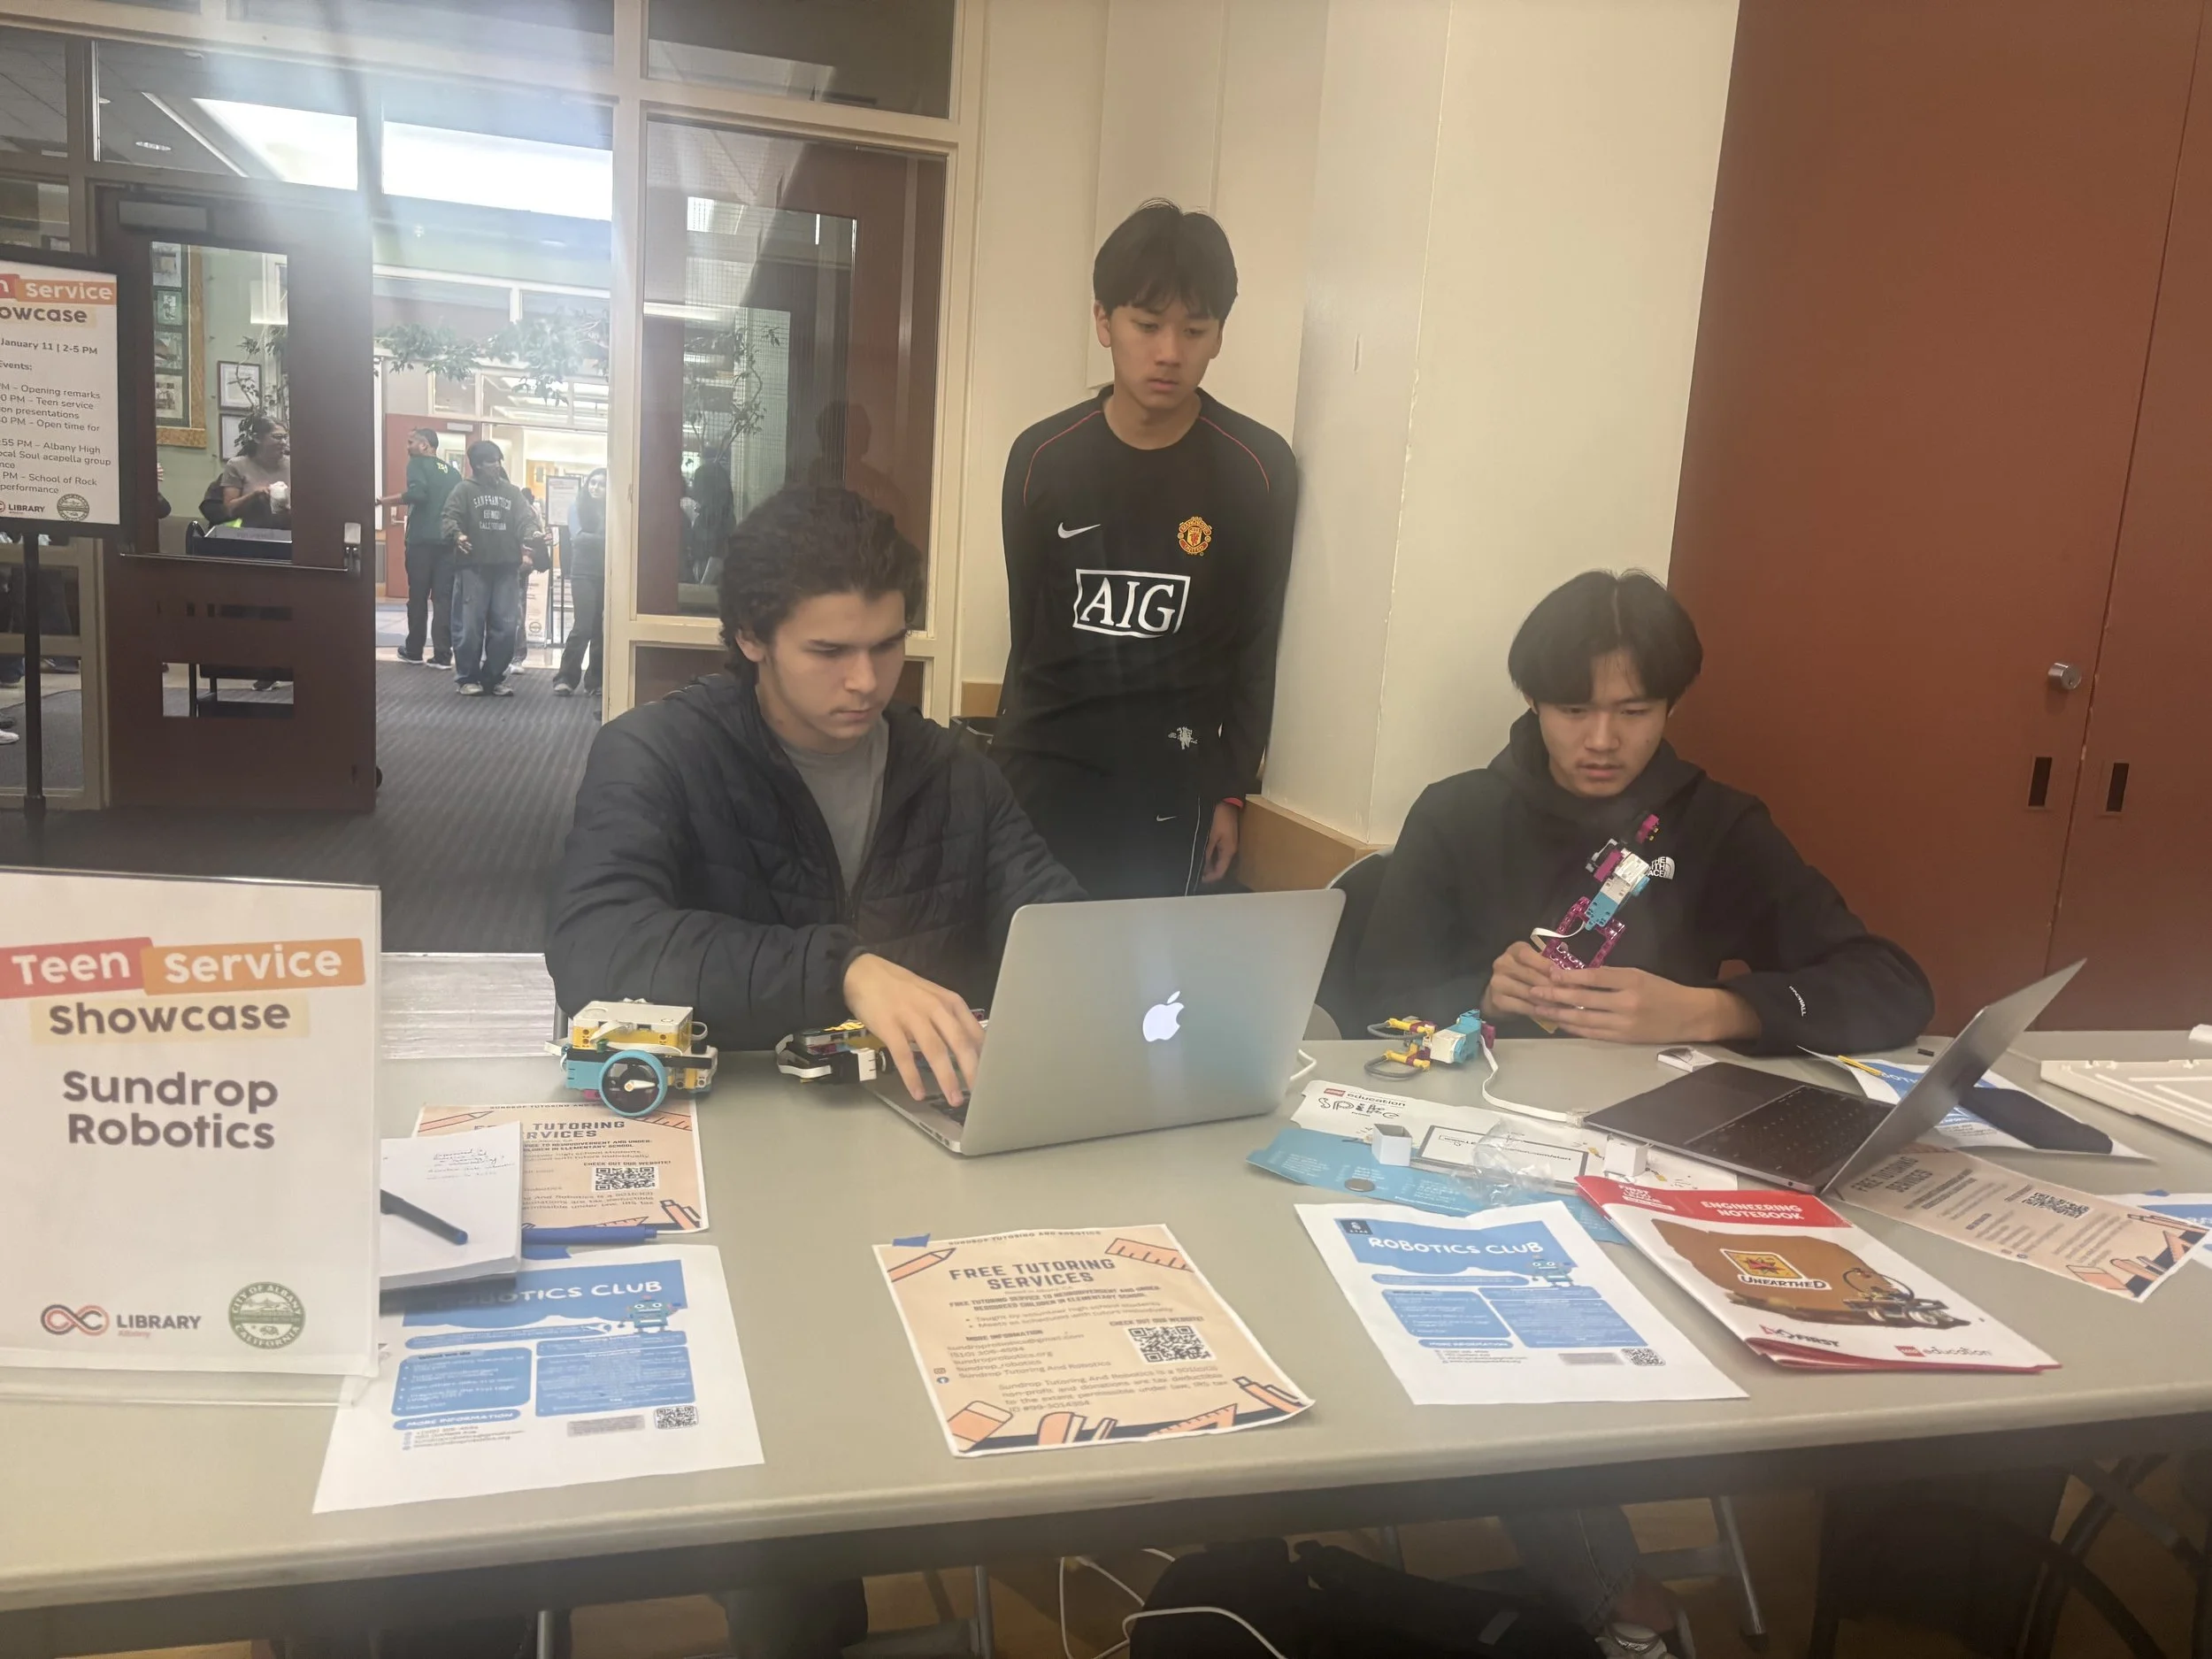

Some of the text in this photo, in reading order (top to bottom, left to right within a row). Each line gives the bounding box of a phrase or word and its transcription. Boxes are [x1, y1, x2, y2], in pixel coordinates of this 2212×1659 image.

[1, 338, 38, 349] January
[63, 344, 80, 353] 2-5
[21, 384, 61, 397] Opening
[63, 390, 101, 399] remarks
[10, 395, 94, 410] PM Teen service
[16, 409, 80, 419] presentations
[11, 417, 26, 426] PM
[36, 419, 62, 429] Open
[65, 422, 85, 431] time
[42, 442, 76, 453] Albany
[80, 445, 101, 455] High
[19, 451, 40, 460] Soul
[42, 453, 81, 464] acapella
[84, 457, 111, 466] group
[28, 473, 61, 483] School
[63, 475, 73, 484] of
[75, 477, 97, 486] Rock
[0, 483, 59, 494] performance
[8, 503, 45, 513] LIBRARY
[1079, 577, 1176, 633] AIG
[12, 950, 131, 985] Teen
[49, 1002, 291, 1035] Showcase
[63, 1071, 279, 1114] Sundrop
[1347, 1093, 1407, 1107] education
[68, 1112, 275, 1149] Robotics
[533, 1121, 626, 1131] TUTORING
[526, 1130, 597, 1140] RVICES
[1700, 1201, 1803, 1213] ENGINEERING
[1717, 1209, 1805, 1221] NOTEBOOK
[1368, 1237, 1544, 1255] ROBOTICS CLUB
[949, 1258, 1116, 1280] FREE TUTORING
[987, 1271, 1094, 1290] SERVICES
[495, 1280, 664, 1303] OTICS CLUB
[116, 1314, 202, 1330] LIBRARY
[990, 1330, 1044, 1340] INFORMATION
[405, 1412, 513, 1428] MORE INFORMATION
